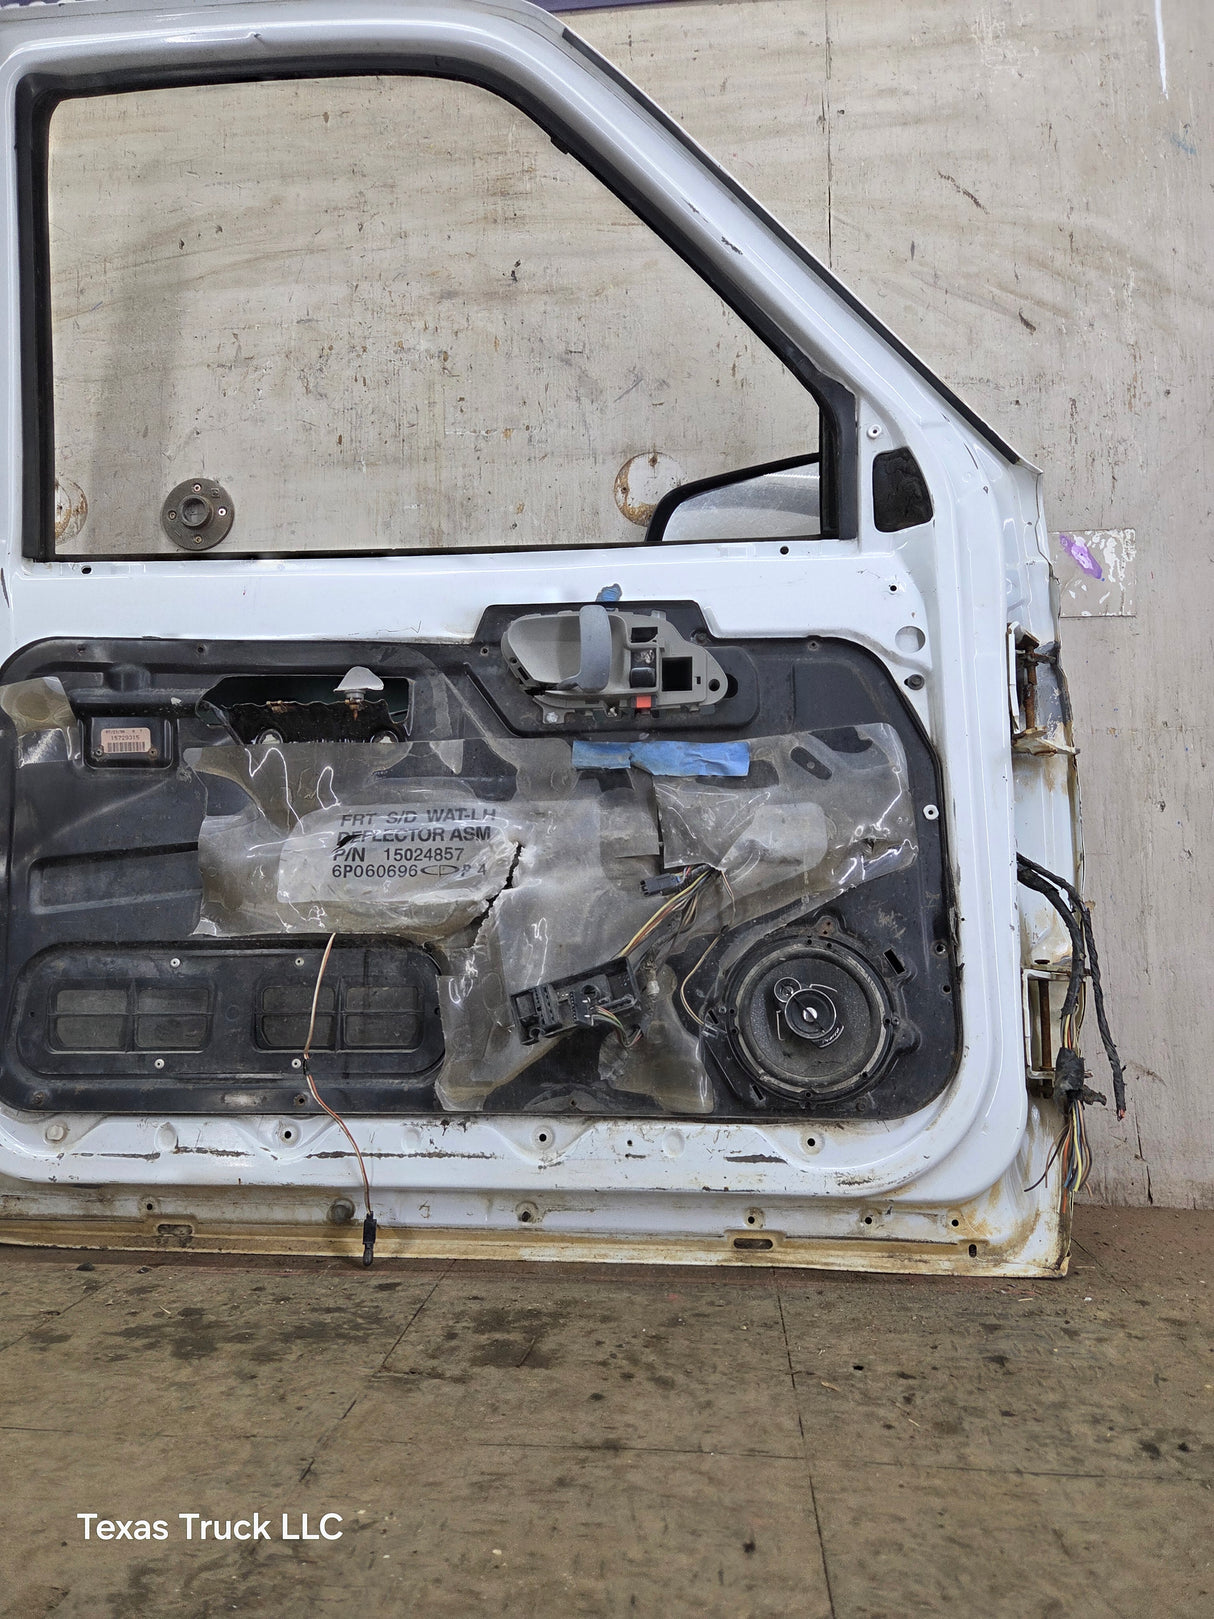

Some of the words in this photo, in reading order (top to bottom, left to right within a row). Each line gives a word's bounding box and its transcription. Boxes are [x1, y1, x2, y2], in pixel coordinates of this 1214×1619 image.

[340, 812, 377, 827] FRT
[385, 810, 418, 825] S/D
[427, 808, 497, 823] WAT-LH
[448, 825, 492, 842] ASM
[332, 847, 366, 862] P/N
[383, 847, 465, 862] 15024857
[331, 864, 418, 879] 6P060696
[477, 863, 487, 876] 4
